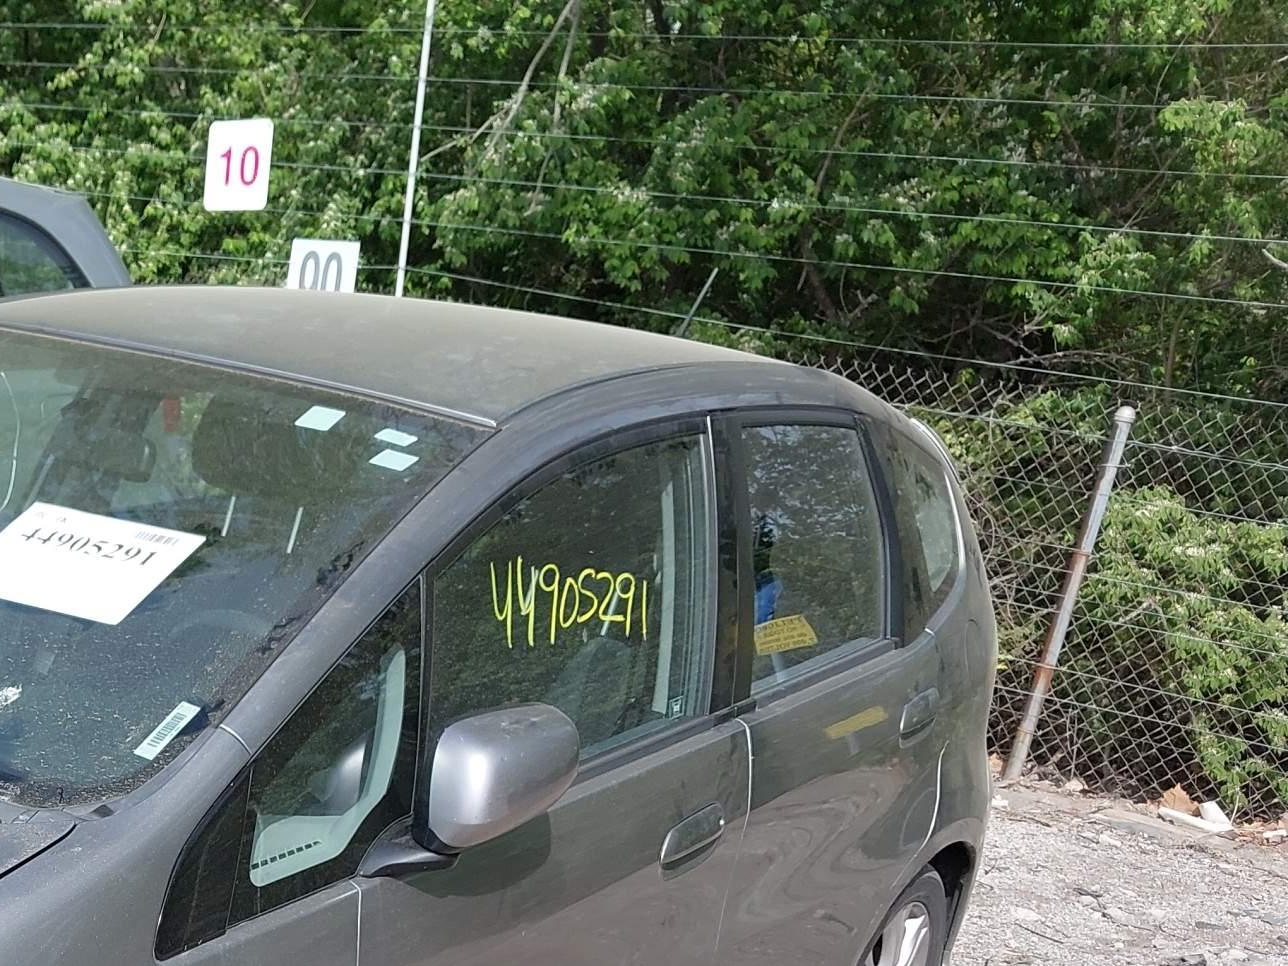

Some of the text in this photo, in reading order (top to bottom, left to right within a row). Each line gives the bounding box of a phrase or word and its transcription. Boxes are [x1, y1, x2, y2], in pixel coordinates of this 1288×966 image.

[220, 145, 260, 187] 10
[21, 526, 158, 567] 44905291
[489, 554, 648, 649] 44905291
